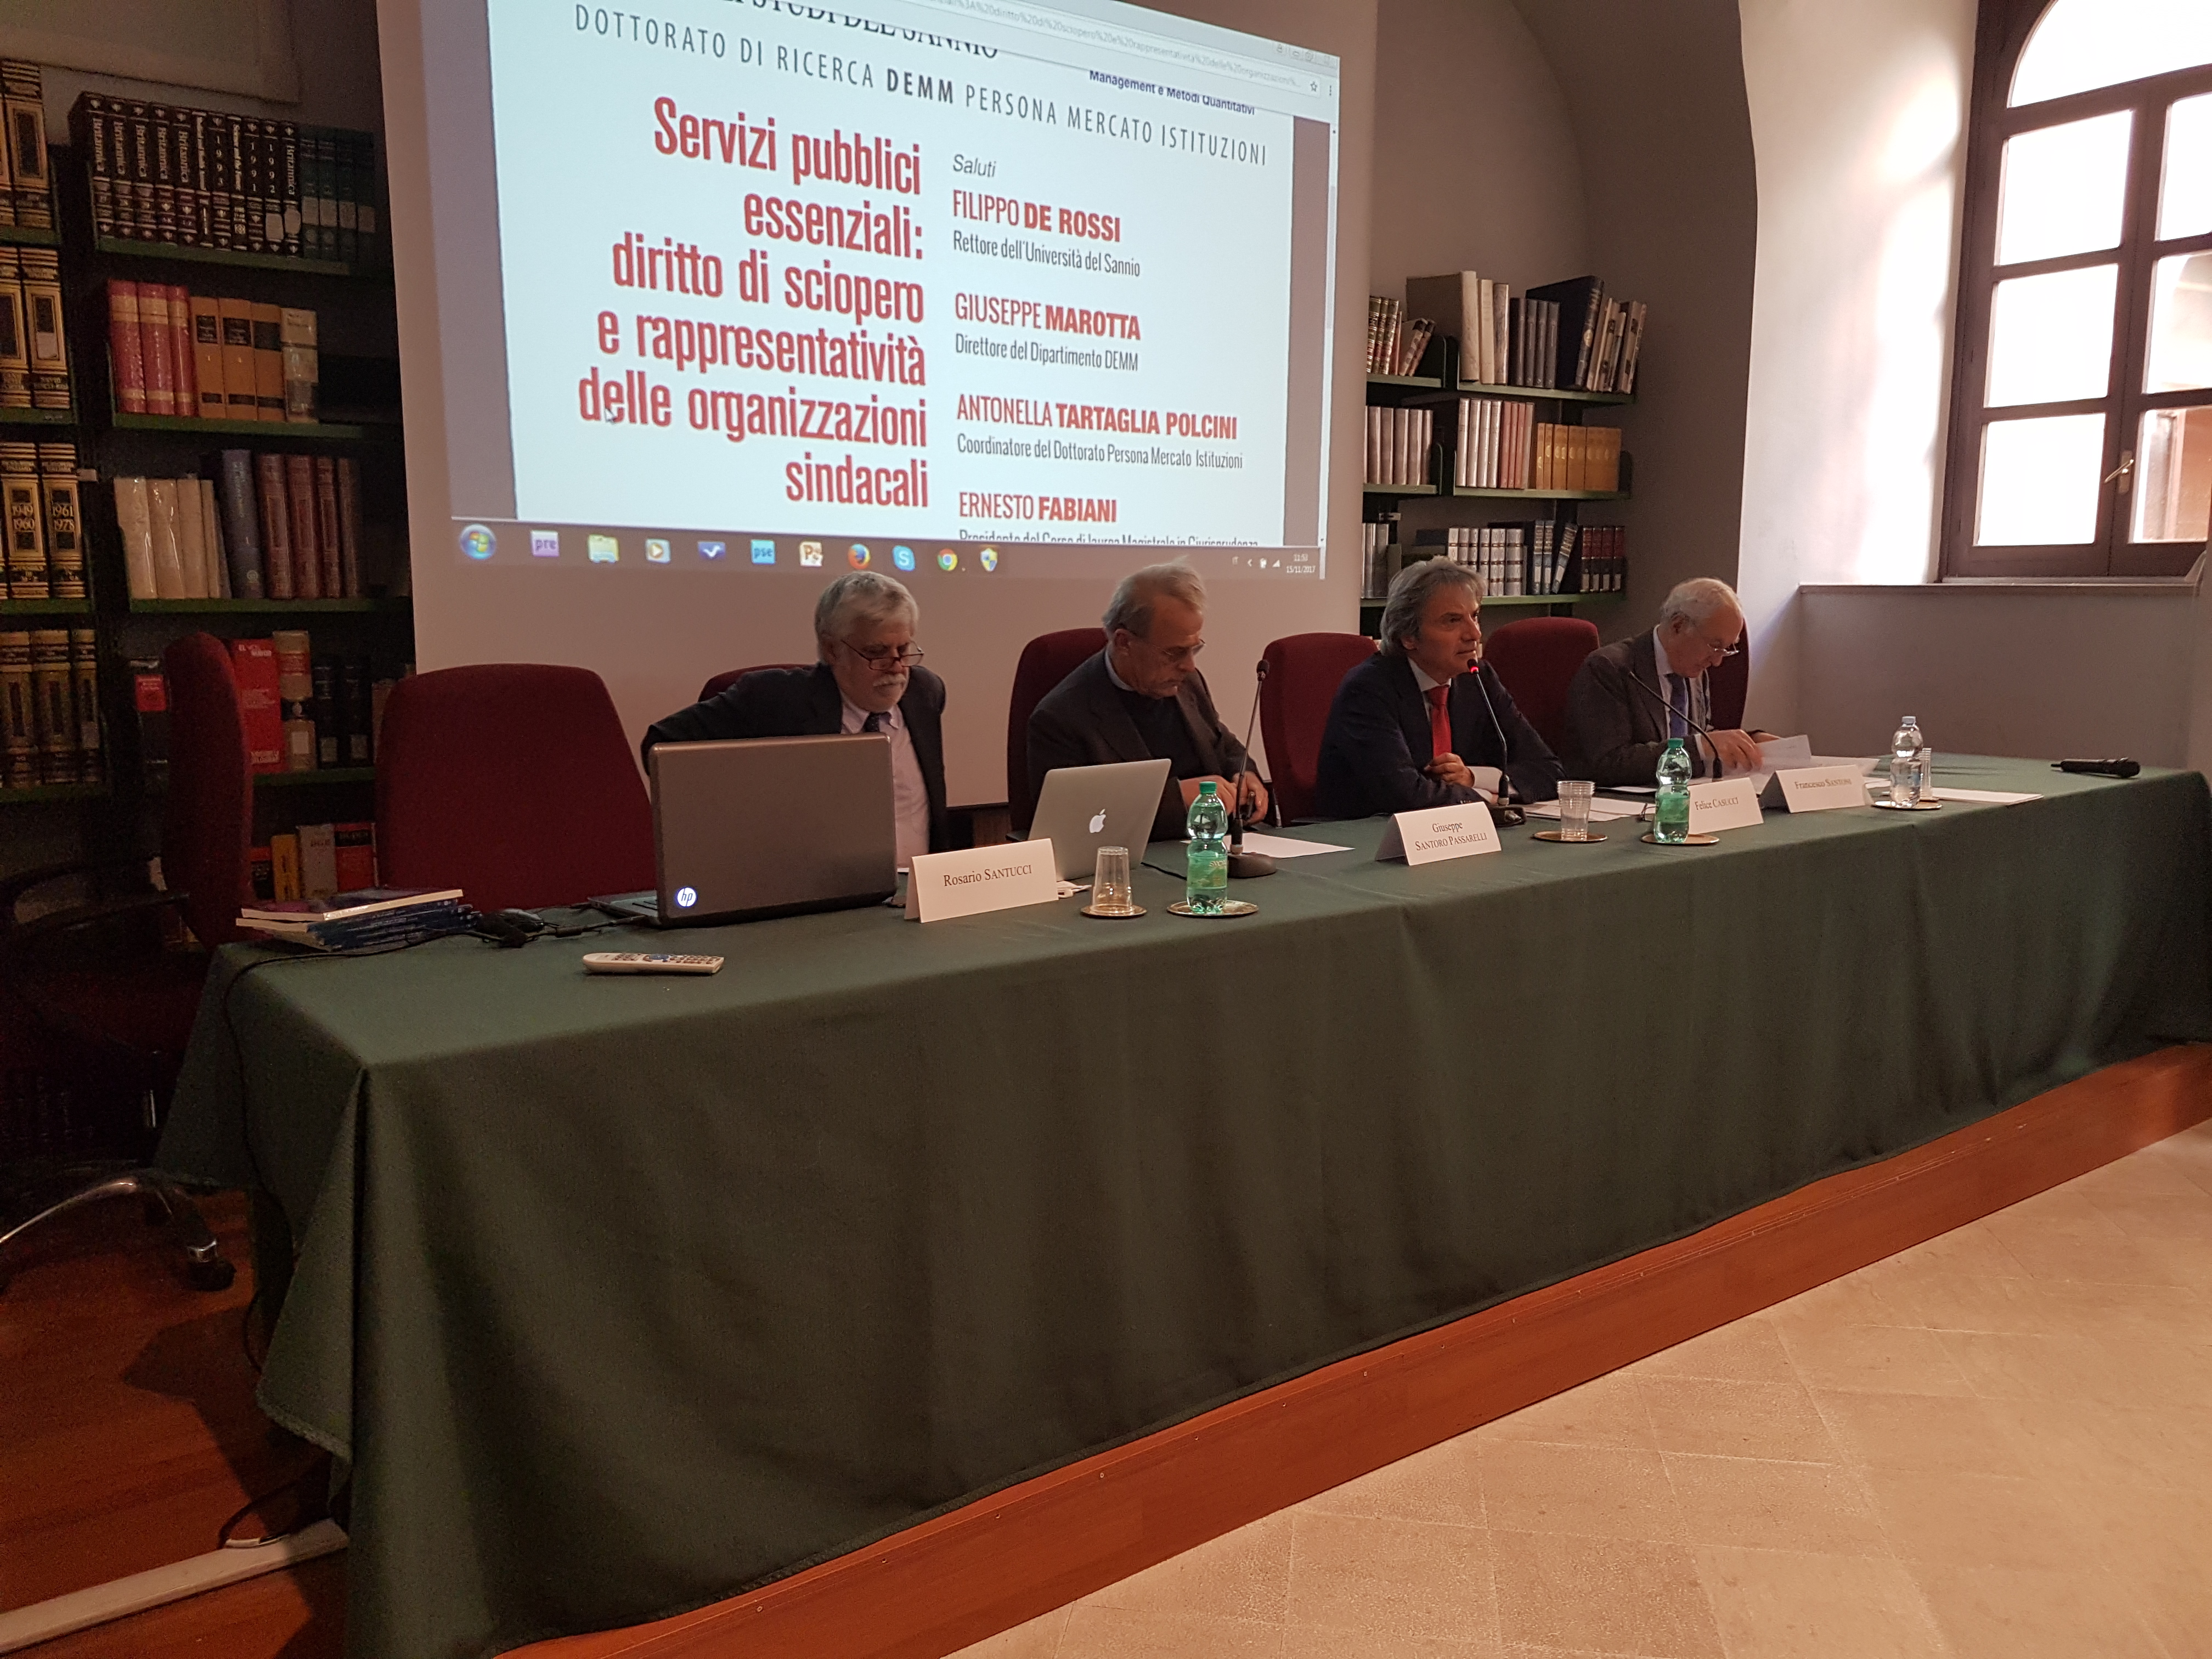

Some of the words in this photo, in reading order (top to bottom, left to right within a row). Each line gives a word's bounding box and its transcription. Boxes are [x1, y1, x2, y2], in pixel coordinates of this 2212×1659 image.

[576, 4, 725, 58] DOTTORATO
[741, 38, 762, 66] DI
[777, 45, 873, 88] RICERCA
[887, 68, 953, 104] DEMM
[966, 84, 1056, 125] PERSONA
[1068, 105, 1152, 143] MERCATO
[1162, 125, 1266, 166] ISTITUZIONI
[1089, 70, 1155, 94] Management
[1158, 87, 1164, 95] e
[1166, 87, 1200, 104] Metodi
[1202, 95, 1255, 116] Quantitativi
[654, 95, 777, 171] Servizi
[792, 129, 921, 195] pubblici
[953, 154, 996, 178] Saluti
[744, 192, 923, 259] essenziali:
[953, 189, 1019, 227] FILIPPO
[1024, 202, 1052, 233] DE
[1059, 207, 1121, 243] ROSSI
[953, 230, 998, 256] Rettore
[1085, 252, 1101, 271] del
[1104, 253, 1141, 277] Sannio
[612, 230, 723, 298] diritto
[739, 248, 769, 304] di
[785, 259, 924, 325] sciopero
[955, 292, 1042, 329] GIUSEPPE
[1045, 304, 1141, 341] MAROTTA
[597, 309, 619, 355] e
[636, 313, 926, 386] rappresentatività
[955, 333, 1007, 358] Direttore
[1010, 340, 1028, 360] del
[1030, 342, 1102, 368] Dipartimento
[1104, 351, 1138, 371] DEMM
[579, 366, 672, 427] delle
[688, 386, 928, 447] organizzazioni
[957, 393, 1053, 427] ANTONELLA
[1056, 403, 1160, 435] TARTAGLIA
[1166, 411, 1237, 440] POLCINI
[957, 433, 1031, 458] Coordinatore
[1034, 439, 1052, 459] del
[1054, 439, 1105, 462] Dottorato
[1108, 444, 1149, 465] Persona
[1151, 447, 1192, 467] Mercato
[1195, 449, 1243, 469] Istituzioni
[785, 452, 928, 508] sindacali
[959, 492, 1035, 520] ERNESTO
[1038, 495, 1117, 523] FABIANI
[1432, 822, 1463, 833] Giuseppe
[1695, 800, 1712, 810] Felice
[1415, 838, 1448, 851] SANTORO
[1448, 832, 1487, 845] PASSARELLI
[680, 888, 693, 907] hp
[943, 870, 981, 887] Rosario
[984, 864, 1032, 881] SANTUCCI
